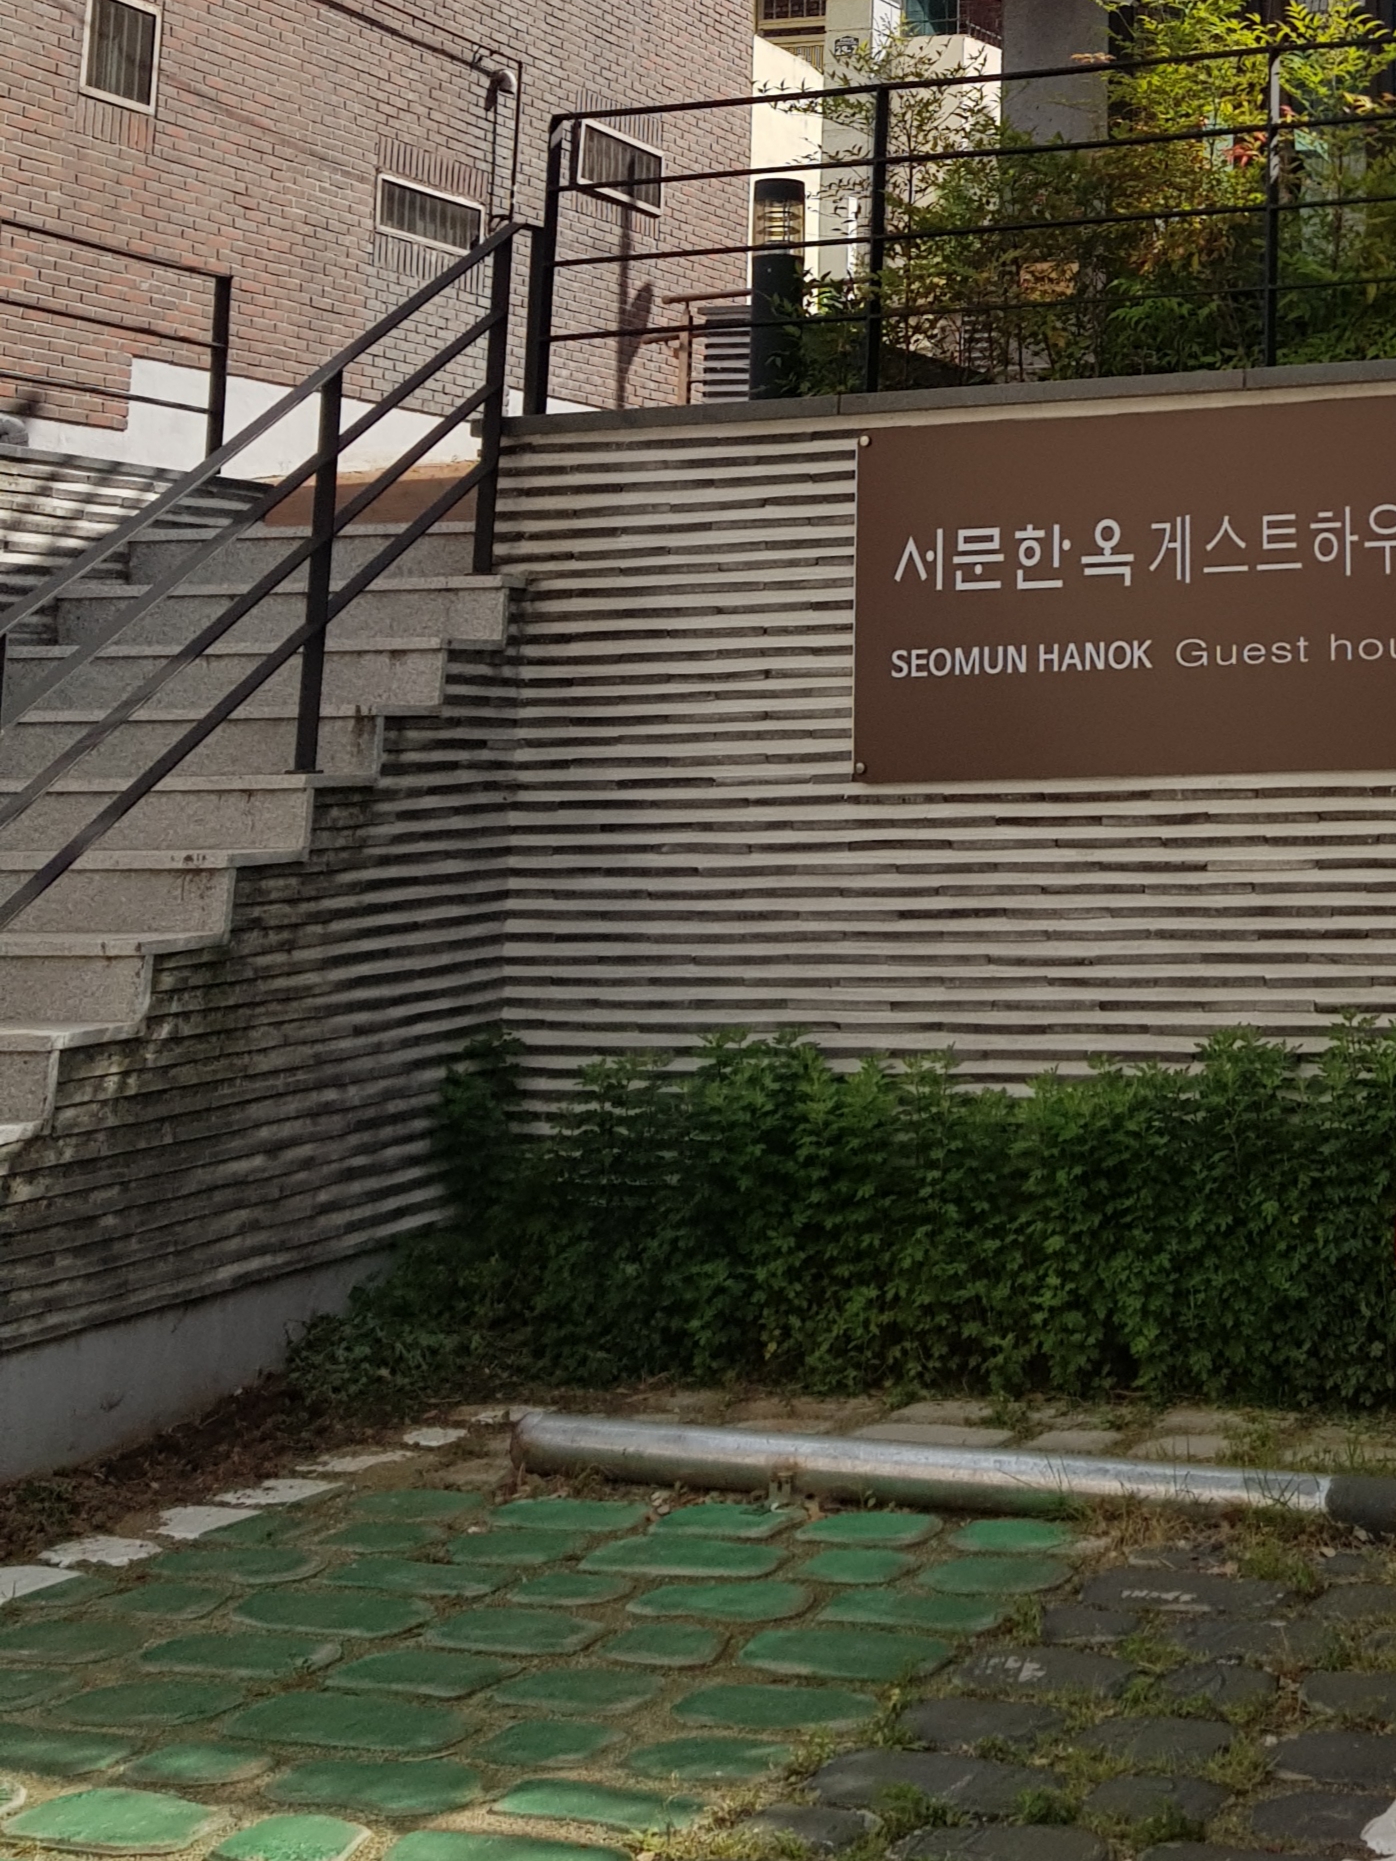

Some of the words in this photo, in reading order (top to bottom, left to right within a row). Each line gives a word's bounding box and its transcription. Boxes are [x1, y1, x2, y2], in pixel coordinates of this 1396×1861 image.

[894, 517, 1135, 591] 서문한옥
[890, 643, 1028, 678] SEOMUN
[1038, 639, 1153, 673] HANOK
[1175, 636, 1309, 668] Guest
